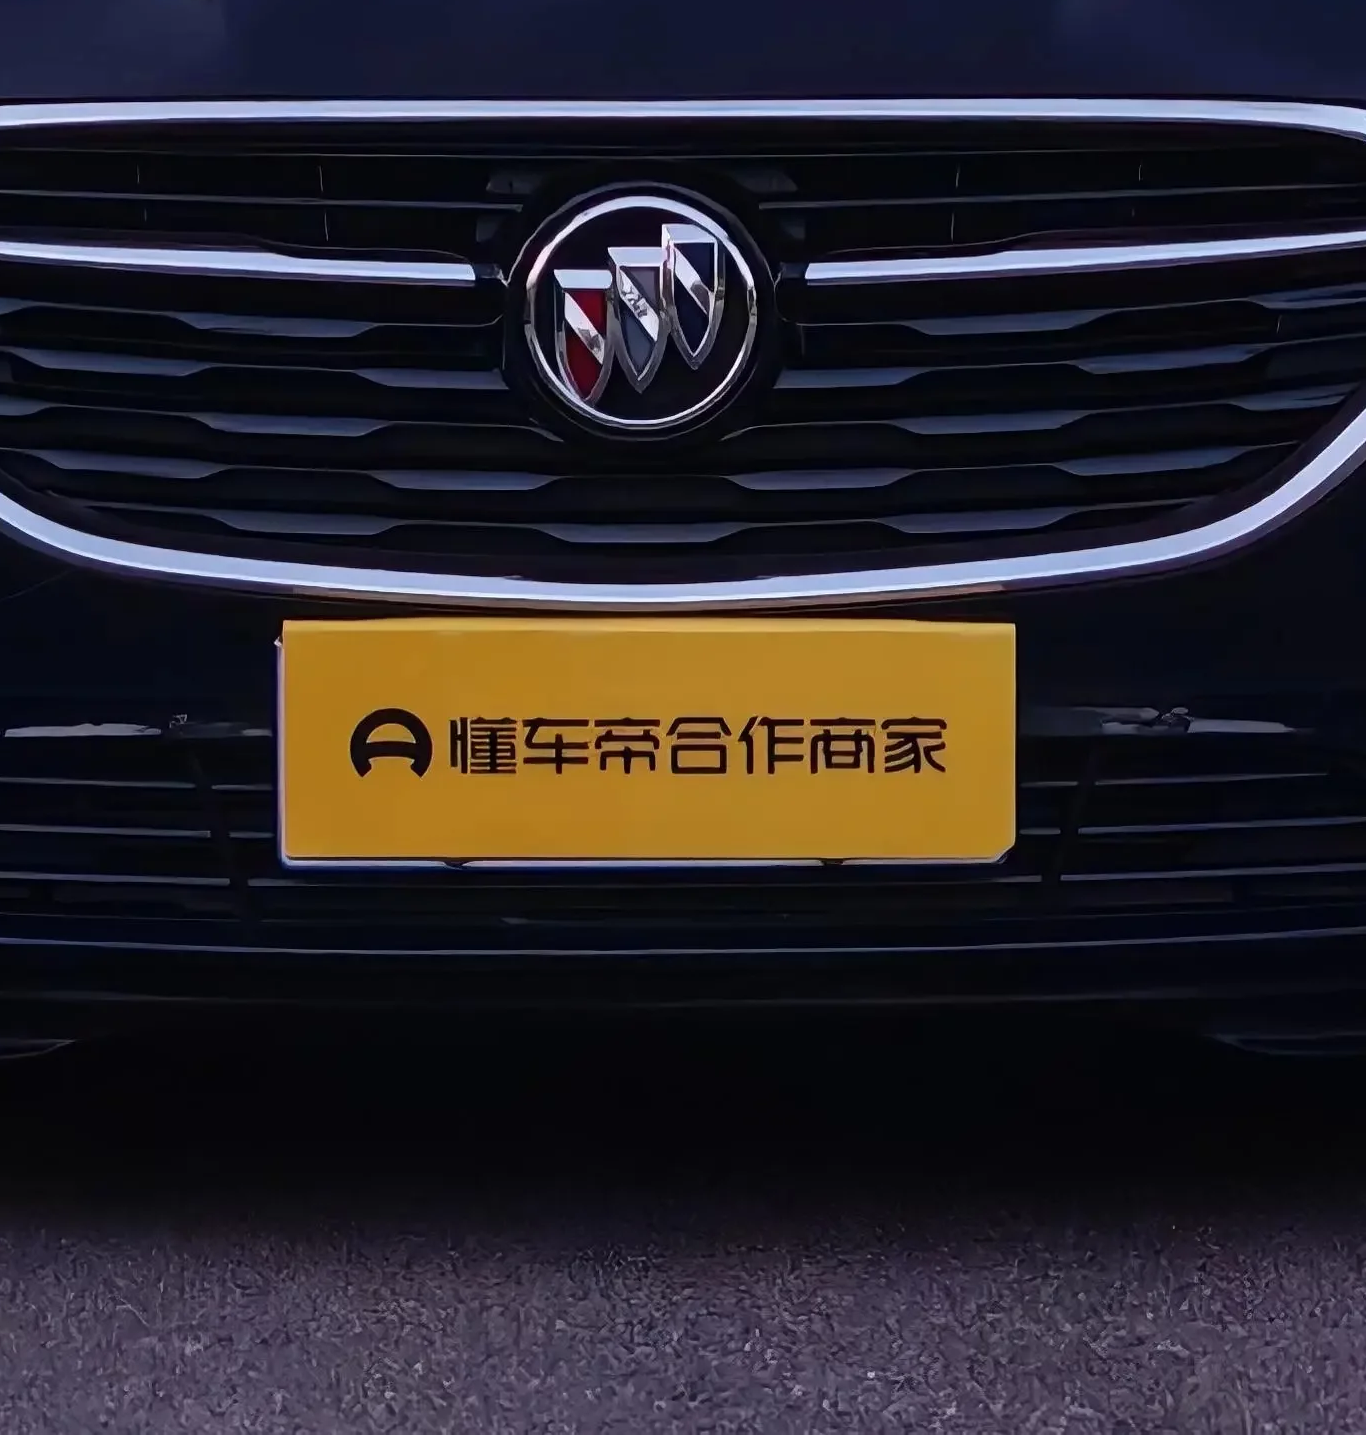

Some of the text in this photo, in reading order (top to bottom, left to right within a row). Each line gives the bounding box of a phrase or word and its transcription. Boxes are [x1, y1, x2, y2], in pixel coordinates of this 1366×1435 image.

[449, 715, 948, 775] 懂车帝合作商家
